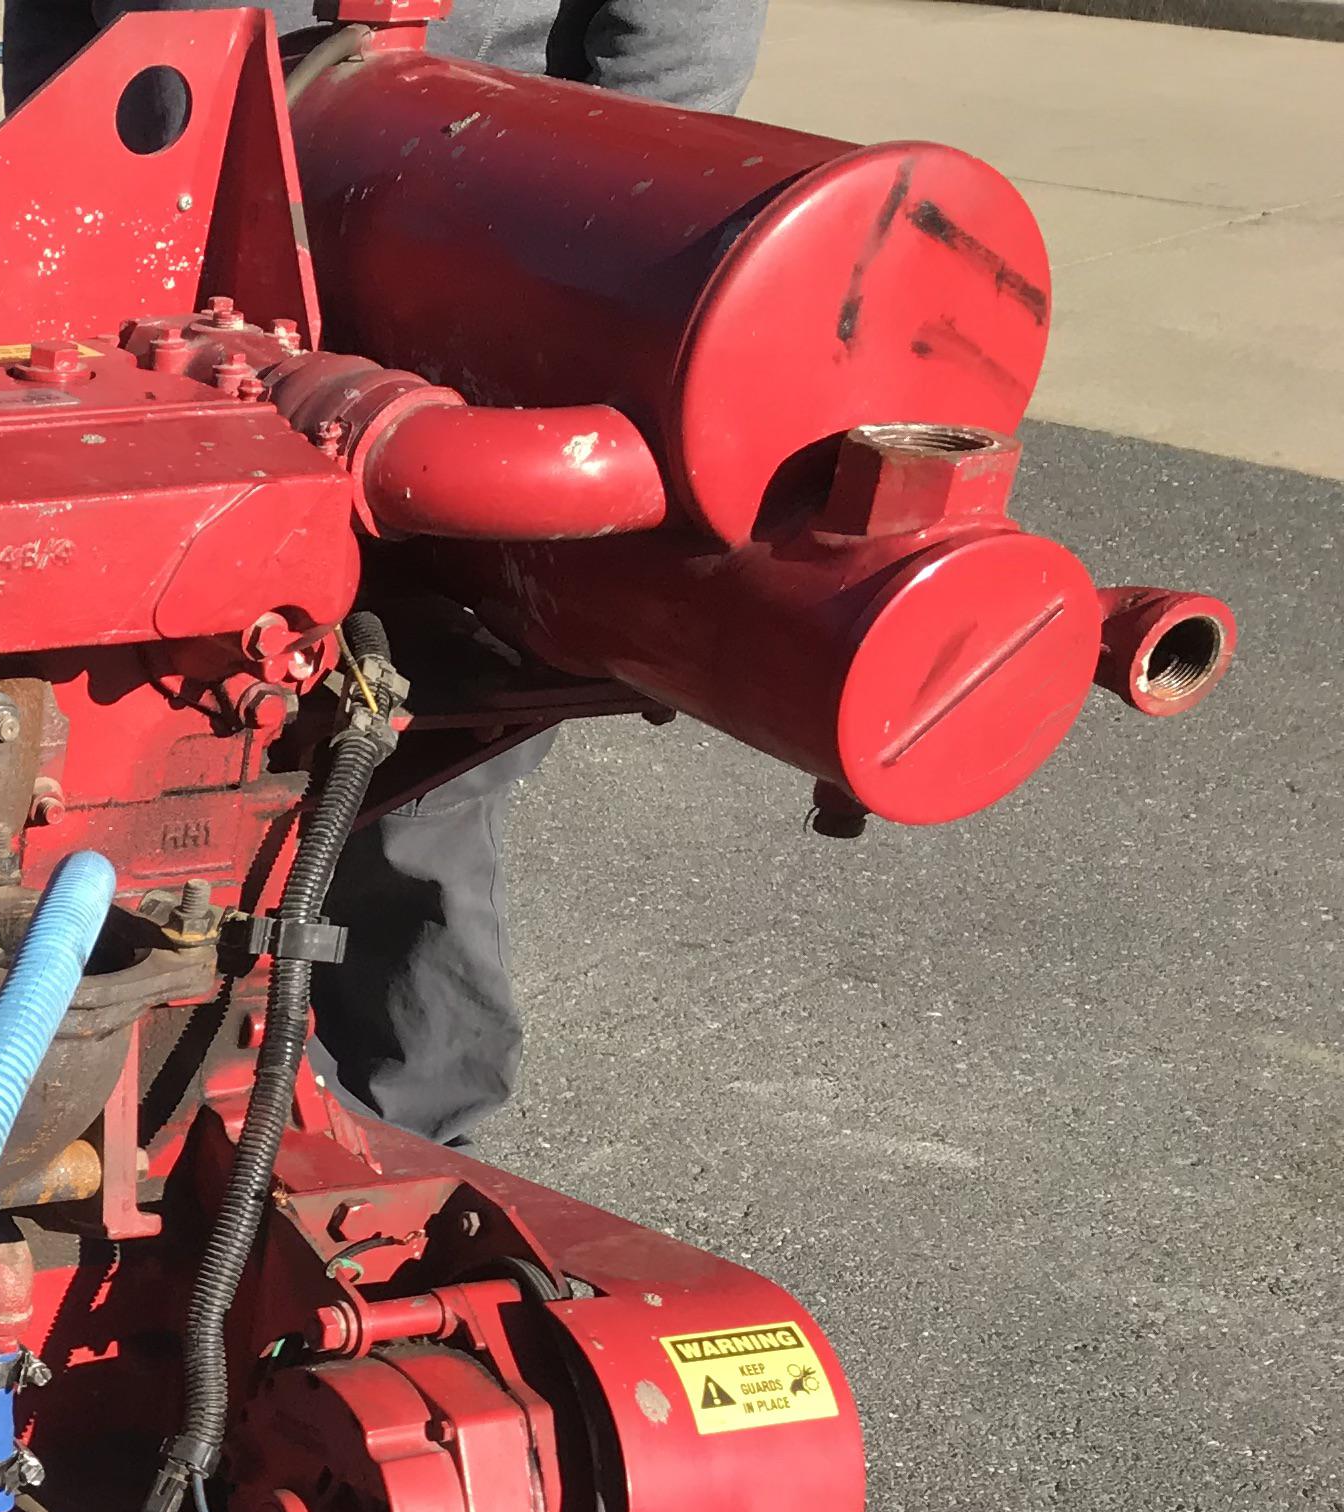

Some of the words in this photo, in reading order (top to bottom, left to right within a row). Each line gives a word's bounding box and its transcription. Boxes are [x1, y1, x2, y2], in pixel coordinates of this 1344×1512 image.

[676, 1330, 799, 1360] WARNING
[738, 1363, 766, 1377] KEEP
[740, 1379, 784, 1395] GUARDS
[743, 1402, 754, 1414] IN
[757, 1397, 791, 1412] PLACE
